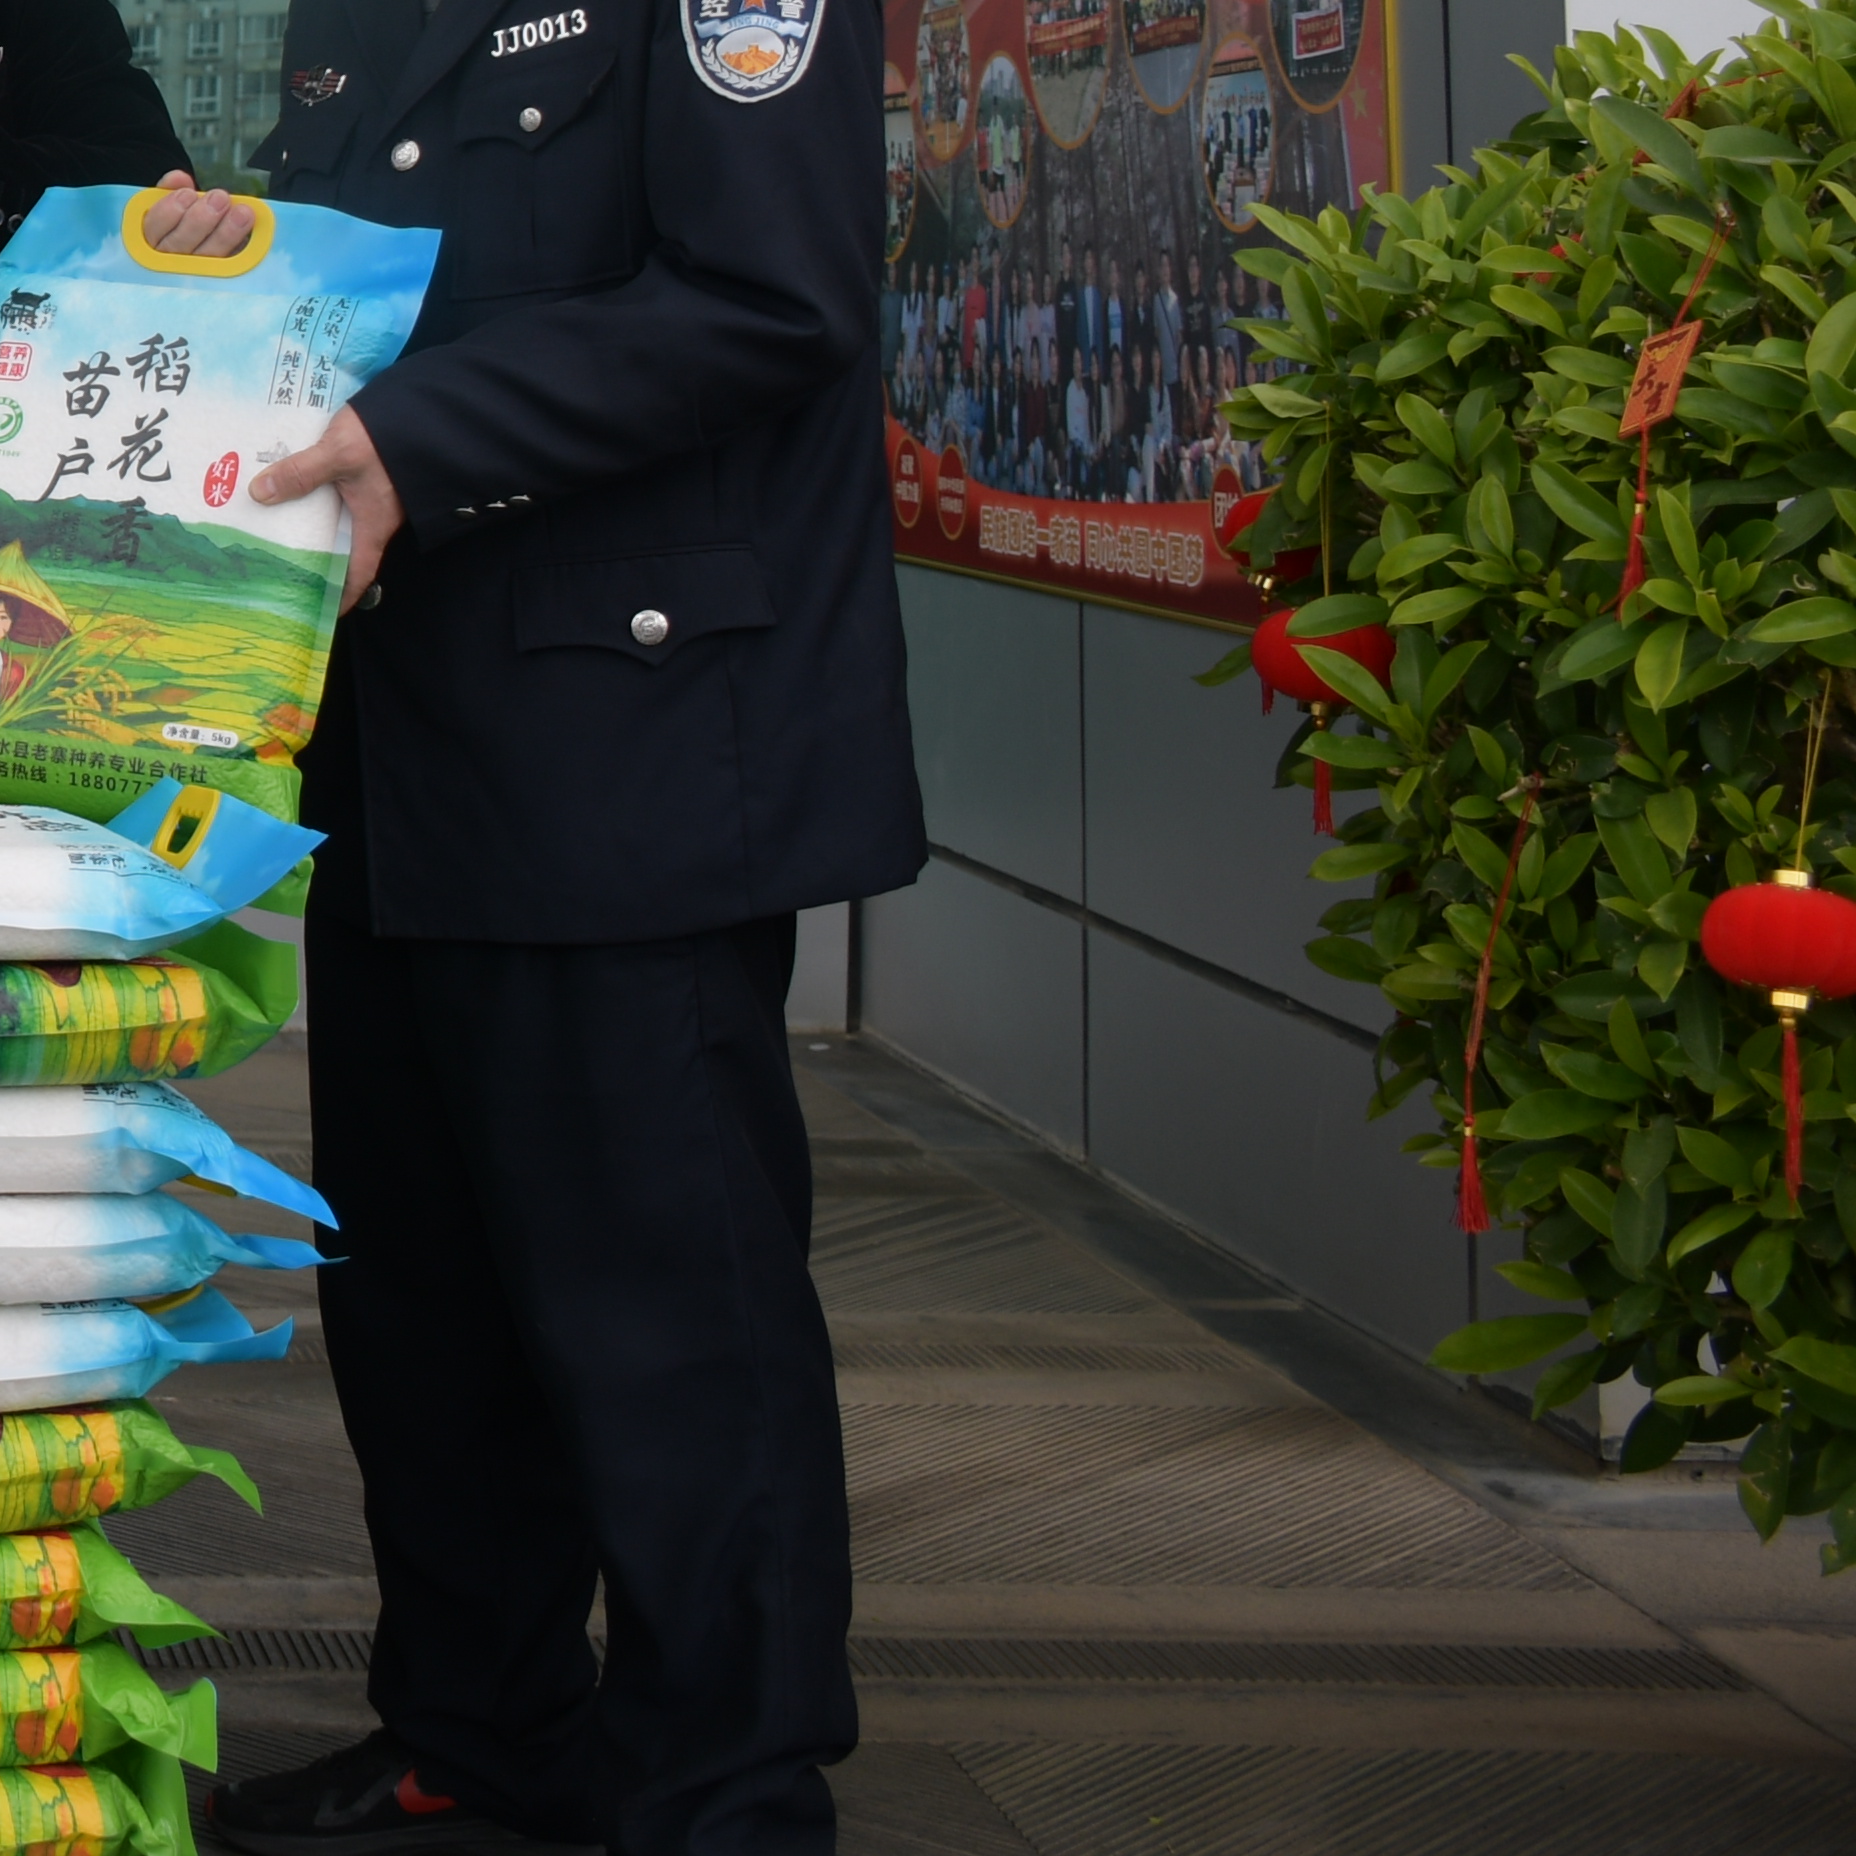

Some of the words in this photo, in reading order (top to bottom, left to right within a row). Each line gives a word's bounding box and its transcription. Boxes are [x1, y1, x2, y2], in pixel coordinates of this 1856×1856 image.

[490, 9, 588, 58] JJ0013
[107, 332, 191, 566] 稻花香
[206, 457, 235, 505] 好米
[979, 504, 1082, 566] 民族团结一家亲
[1085, 521, 1206, 588] 同心共圆中国梦
